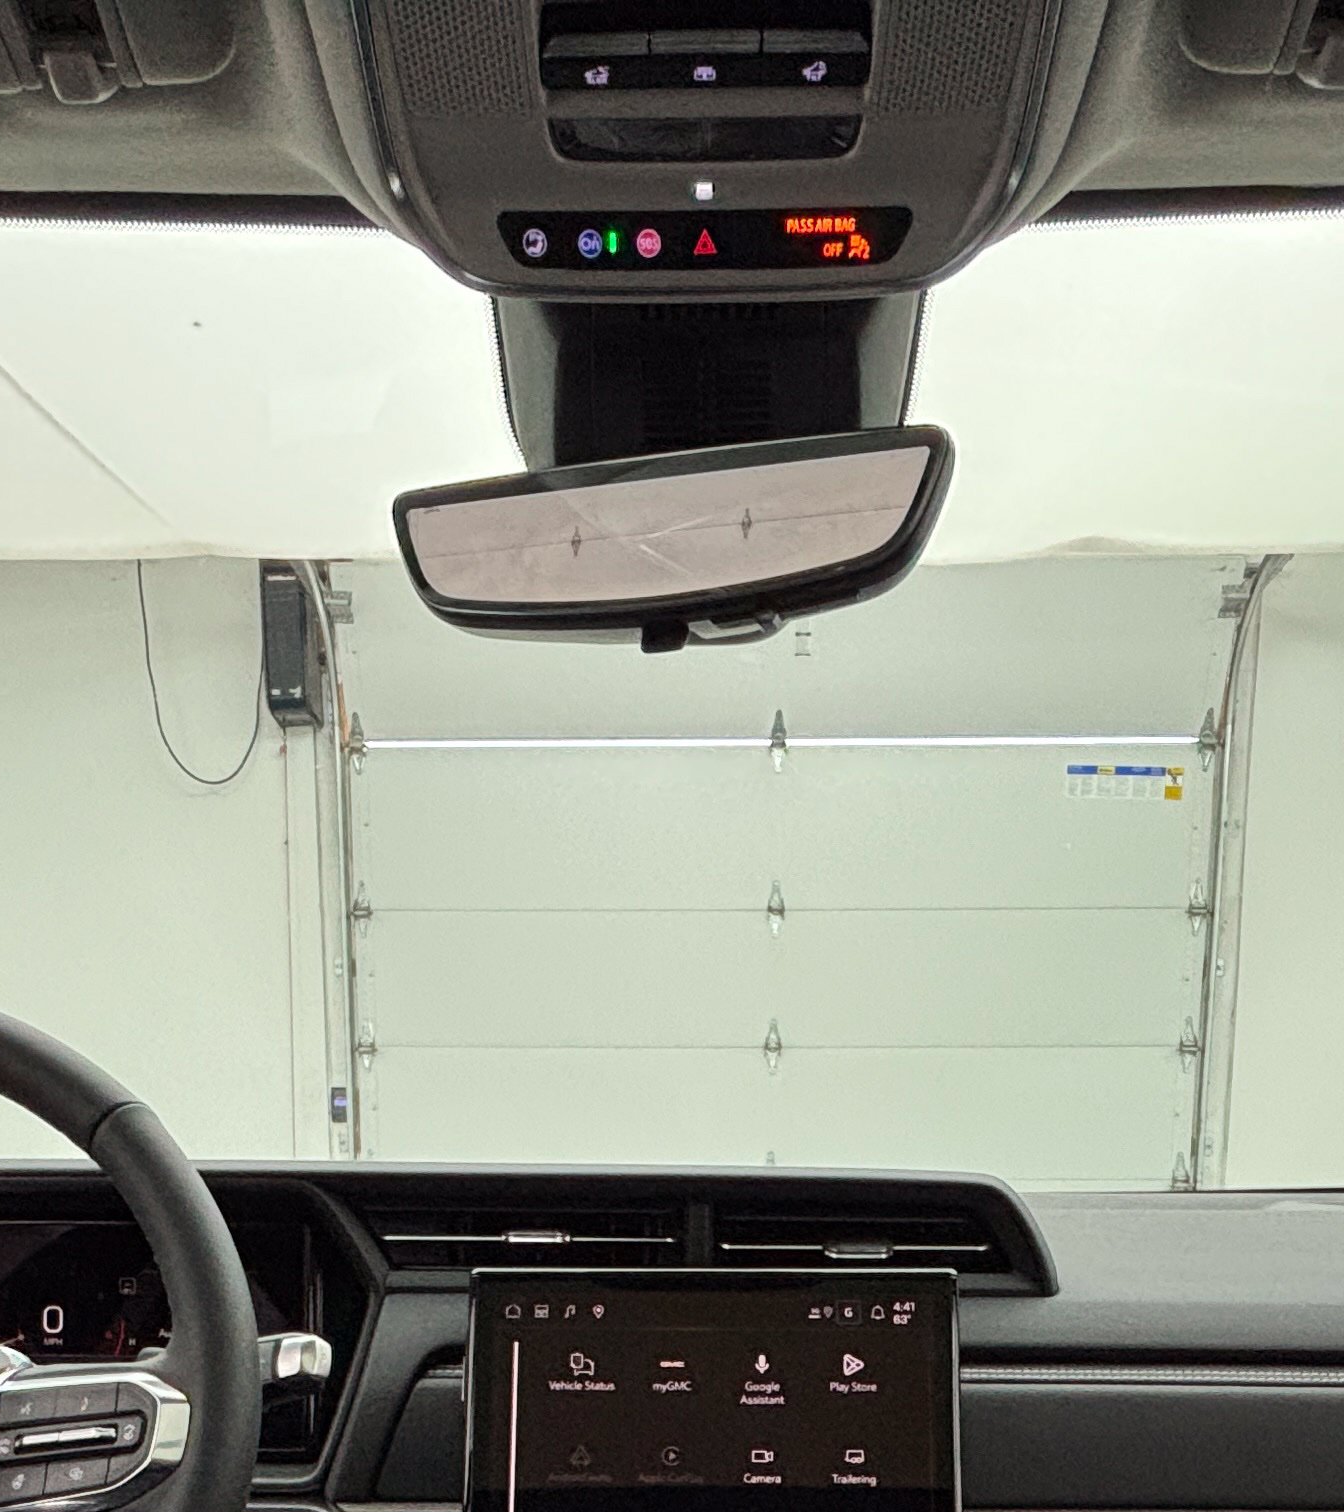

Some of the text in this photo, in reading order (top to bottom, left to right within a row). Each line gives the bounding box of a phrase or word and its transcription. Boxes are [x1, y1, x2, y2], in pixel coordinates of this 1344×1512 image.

[787, 218, 856, 233] PASS AIR BAG
[639, 238, 658, 250] SOS
[823, 243, 843, 257] OFF
[892, 1302, 916, 1312] 4:41
[42, 1305, 64, 1334] 0
[549, 1381, 616, 1391] Vehicle Status
[652, 1381, 692, 1393] myGMC
[745, 1382, 780, 1394] Google
[830, 1382, 877, 1393] Play Store
[740, 1395, 785, 1405] Assistant
[744, 1473, 781, 1483] Camera
[832, 1474, 876, 1486] Trailering
